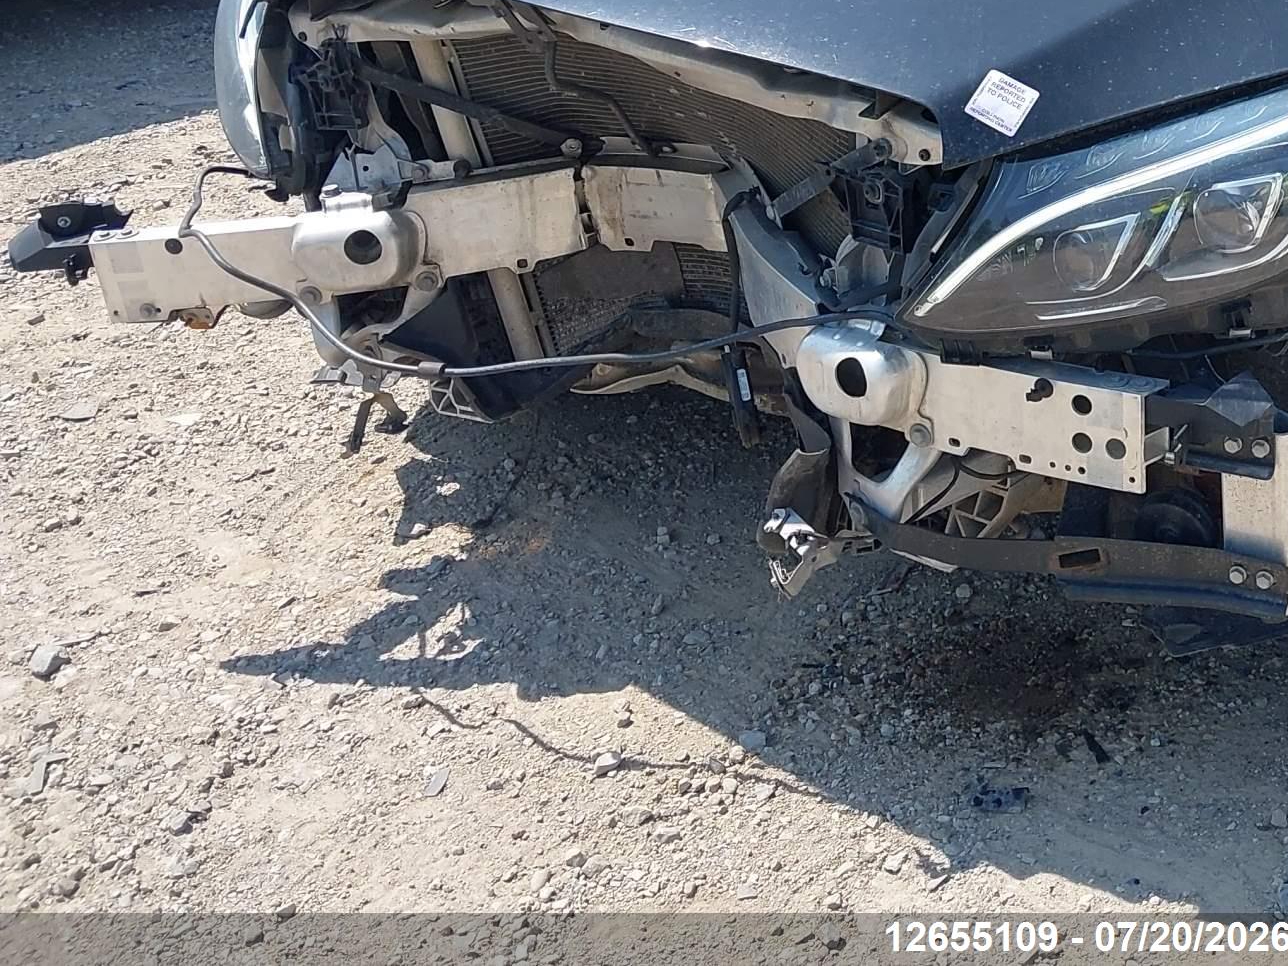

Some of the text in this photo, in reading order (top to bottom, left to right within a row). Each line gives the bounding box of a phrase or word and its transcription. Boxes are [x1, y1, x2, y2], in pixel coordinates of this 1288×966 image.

[990, 81, 1026, 103] REPORTED
[998, 77, 1026, 95] DAMAGE
[987, 87, 997, 96] TO
[997, 93, 1023, 110] POLICE
